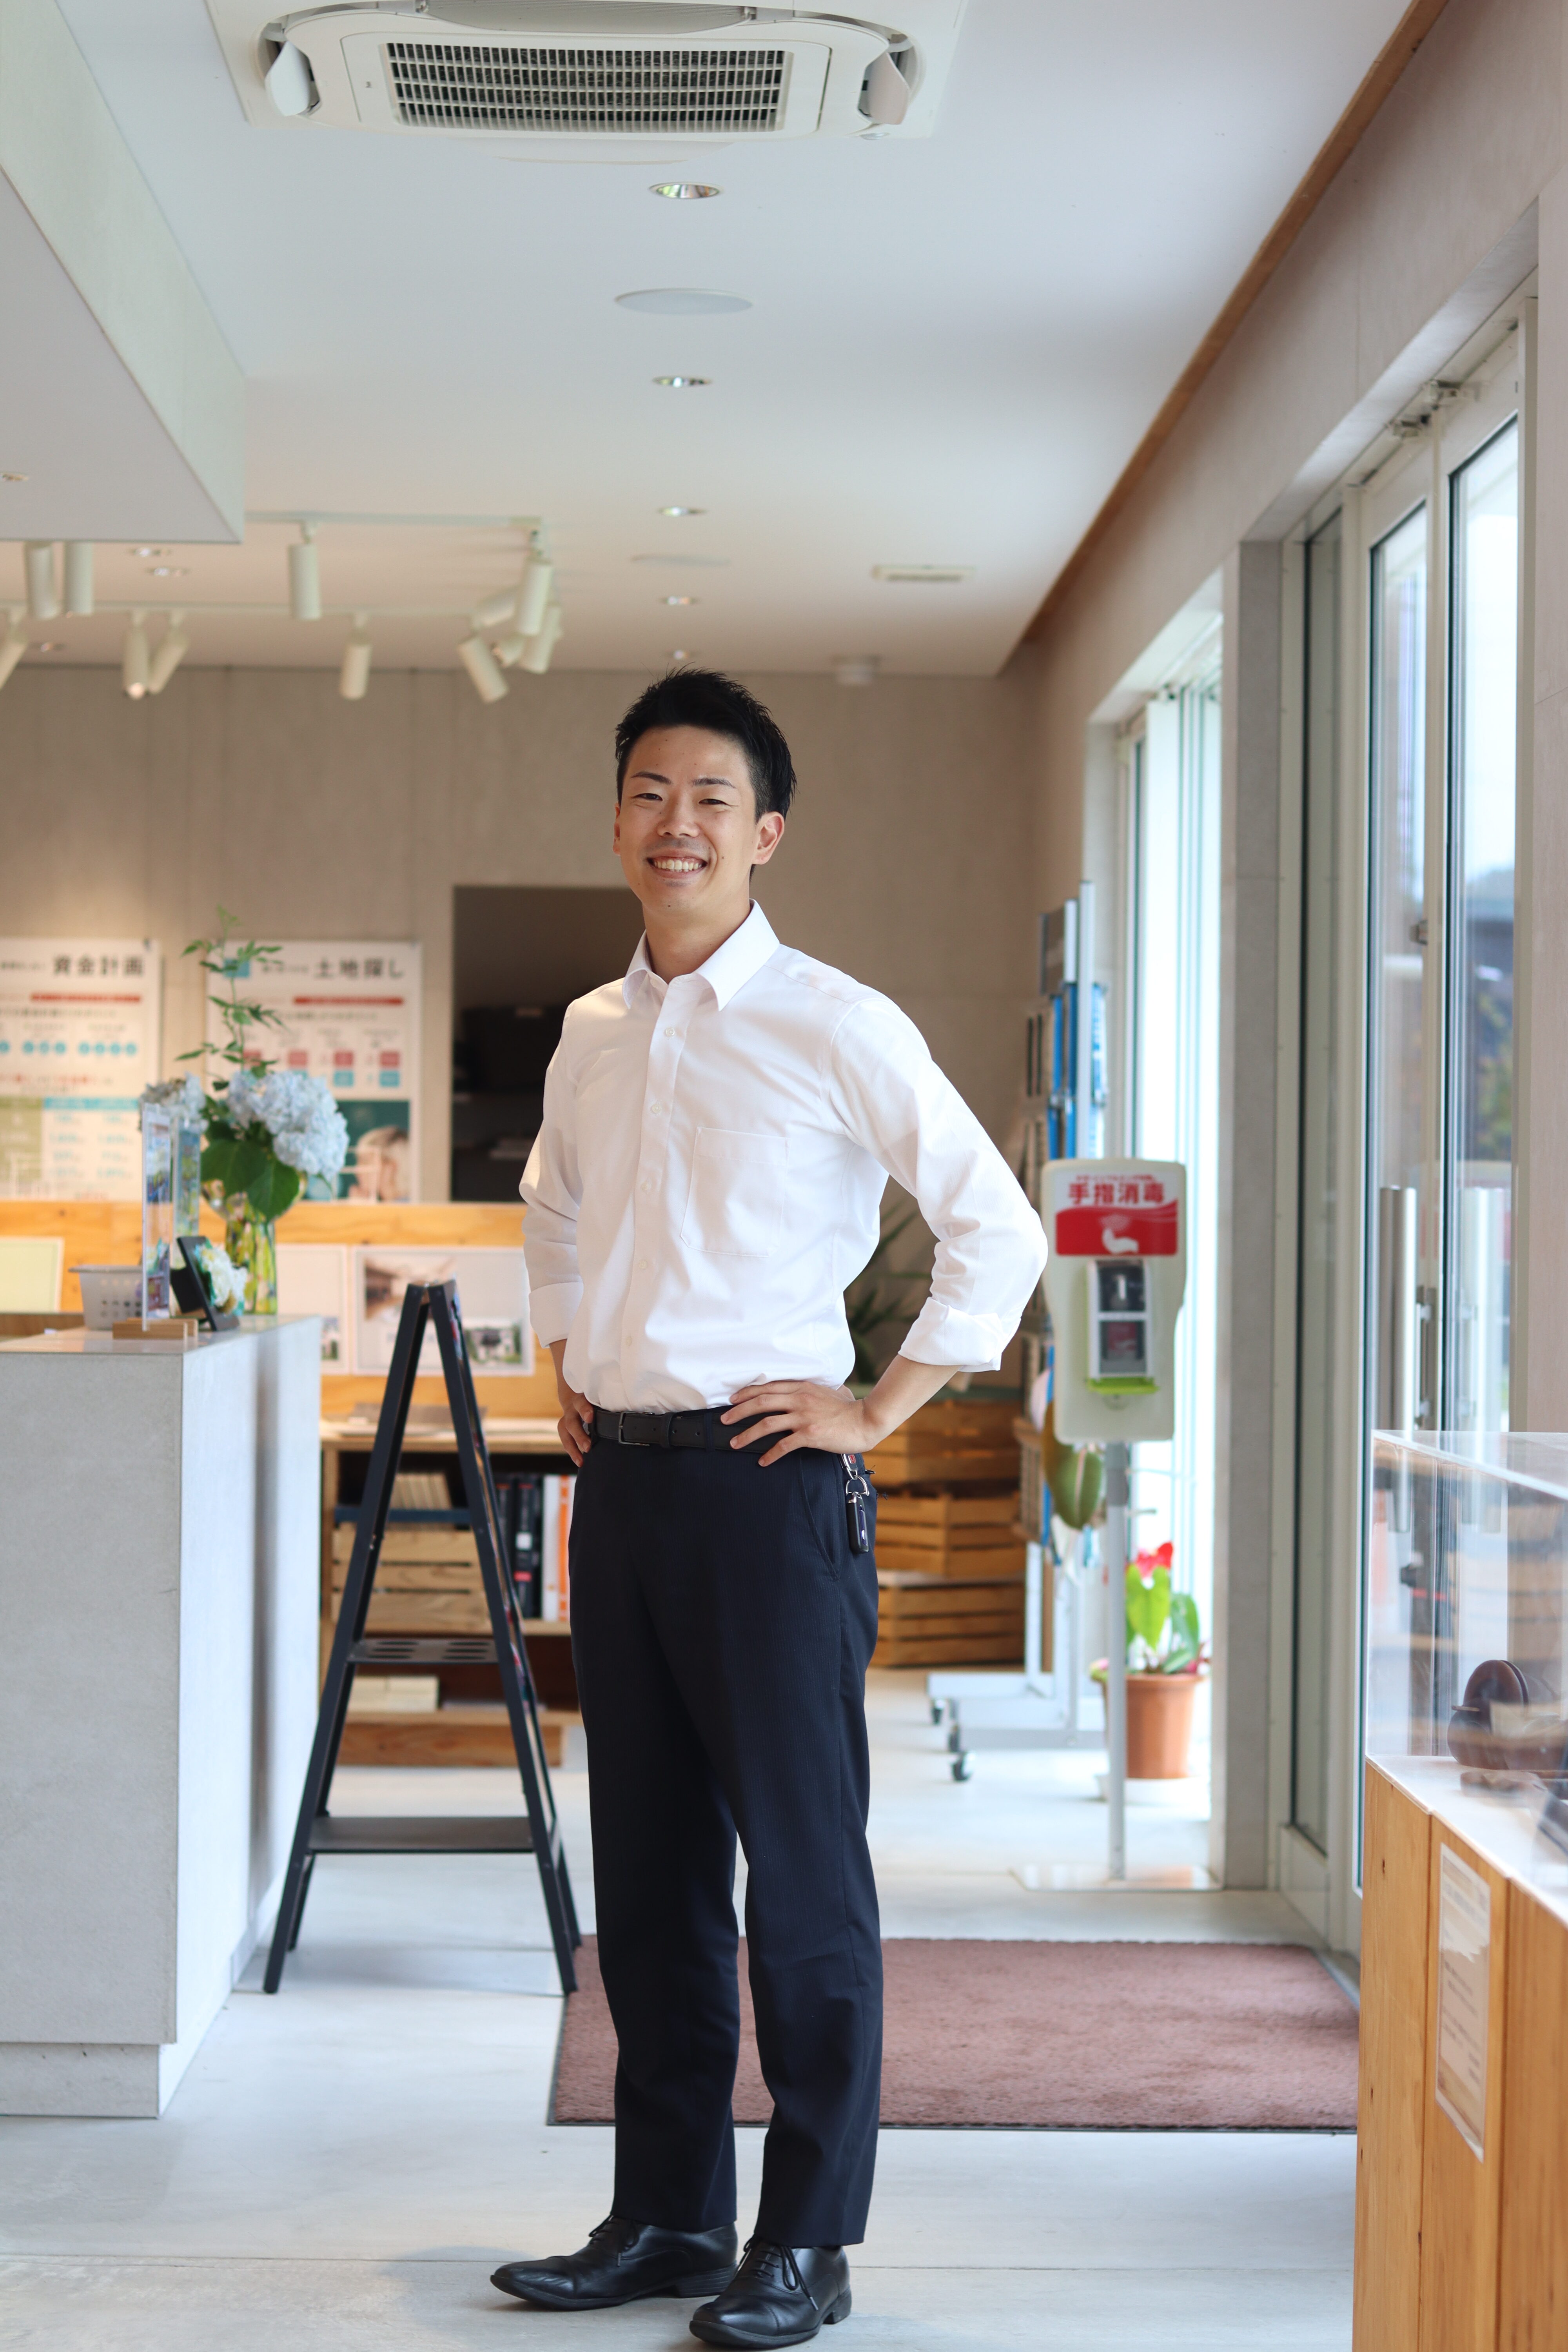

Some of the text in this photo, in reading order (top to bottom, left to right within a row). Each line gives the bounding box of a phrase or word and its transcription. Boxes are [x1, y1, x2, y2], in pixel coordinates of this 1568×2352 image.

[54, 954, 144, 976] 資金計画
[314, 956, 404, 980] 土地探し
[1069, 1183, 1164, 1205] 手指消毒
